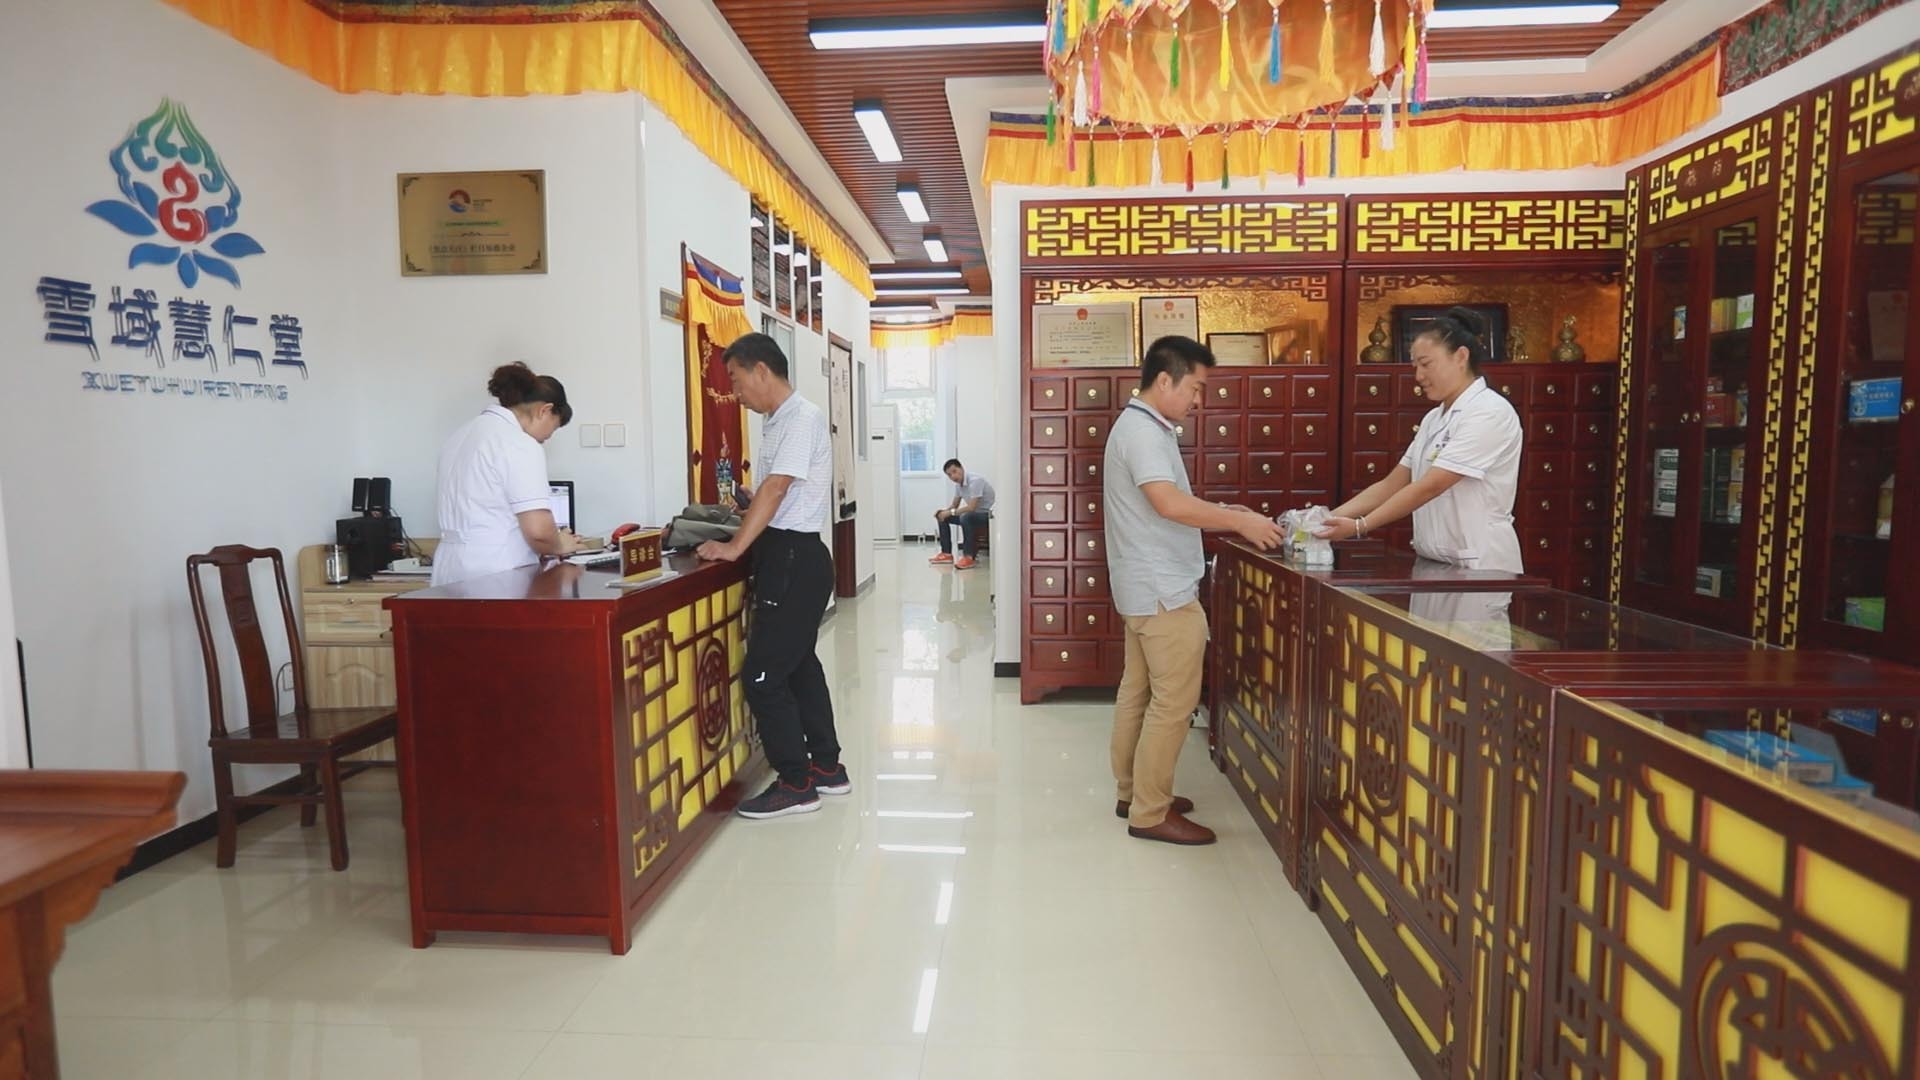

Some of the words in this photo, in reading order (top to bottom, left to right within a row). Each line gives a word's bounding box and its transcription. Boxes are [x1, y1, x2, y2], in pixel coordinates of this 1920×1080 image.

[37, 275, 308, 380] 雪域慧仁堂
